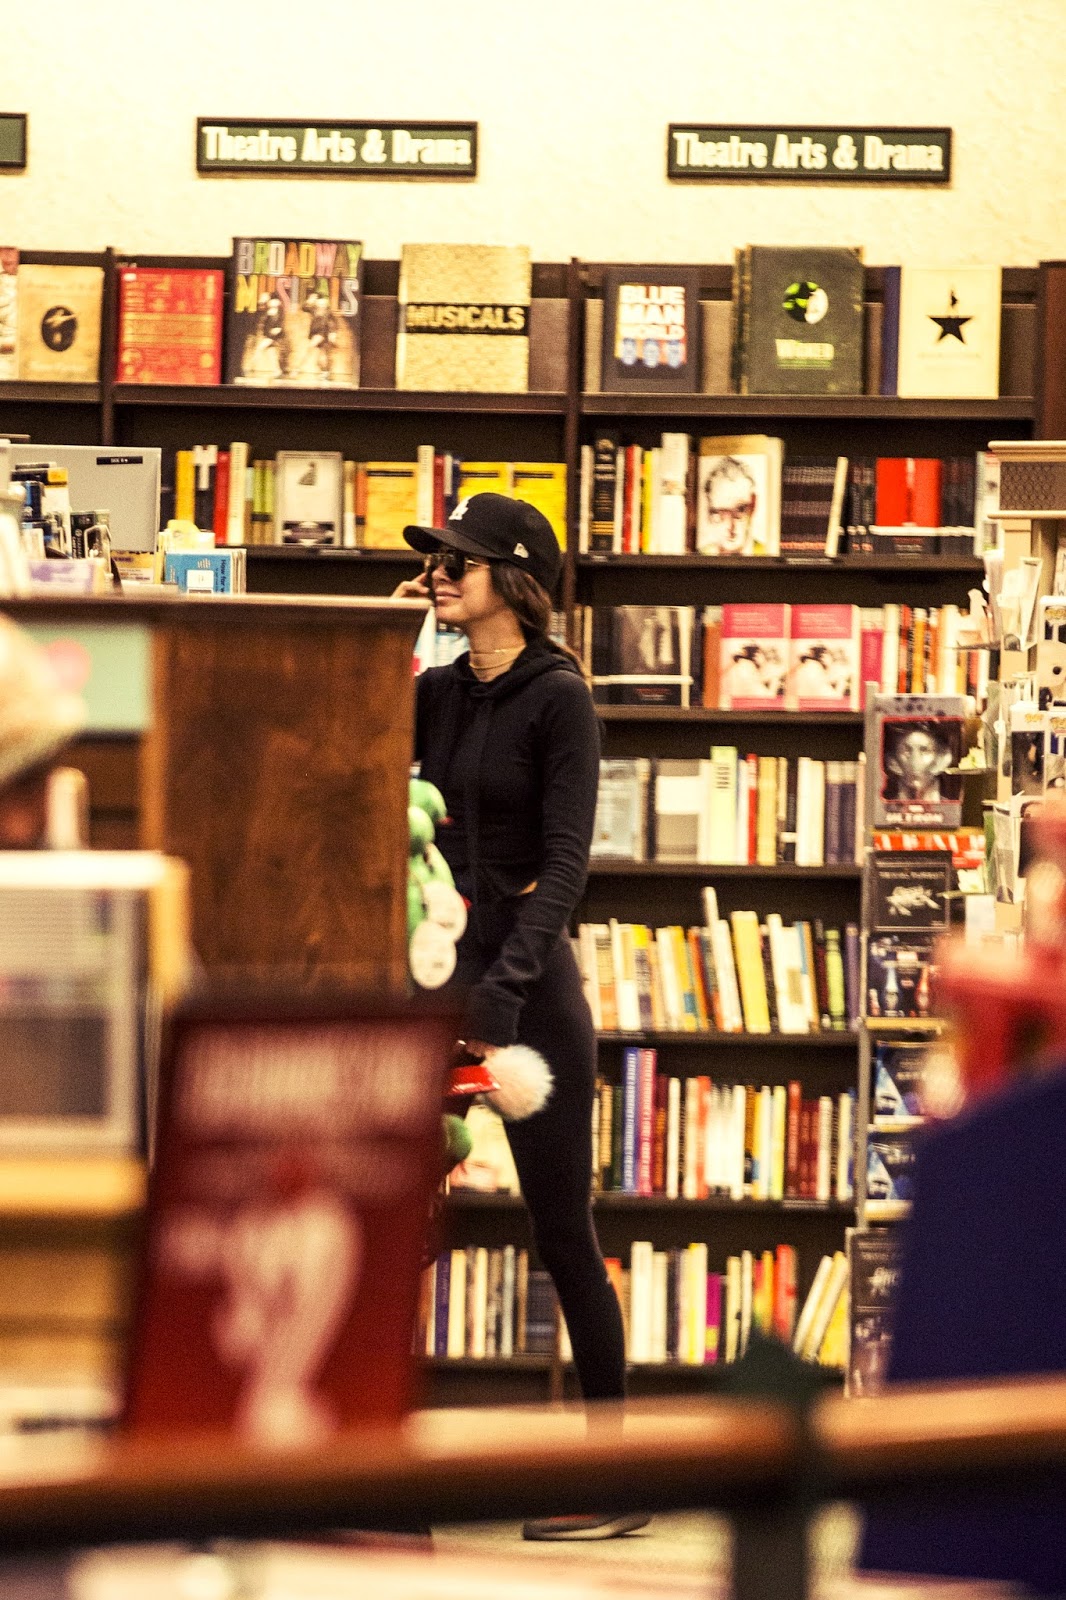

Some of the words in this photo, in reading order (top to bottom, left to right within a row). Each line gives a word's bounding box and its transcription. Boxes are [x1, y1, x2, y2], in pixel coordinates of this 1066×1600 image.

[202, 126, 297, 162] Theatre
[302, 128, 355, 163] Arts
[360, 129, 387, 163] &
[392, 129, 472, 164] Drama
[673, 132, 768, 168] Theatre
[772, 134, 827, 169] Arts
[832, 135, 858, 170] &
[864, 135, 943, 171] Drama
[238, 240, 363, 277] BROADWAY
[235, 274, 359, 316] MUSICALS
[619, 285, 686, 303] BLUE
[405, 305, 525, 330] MUSICALS
[619, 304, 686, 324] MAN
